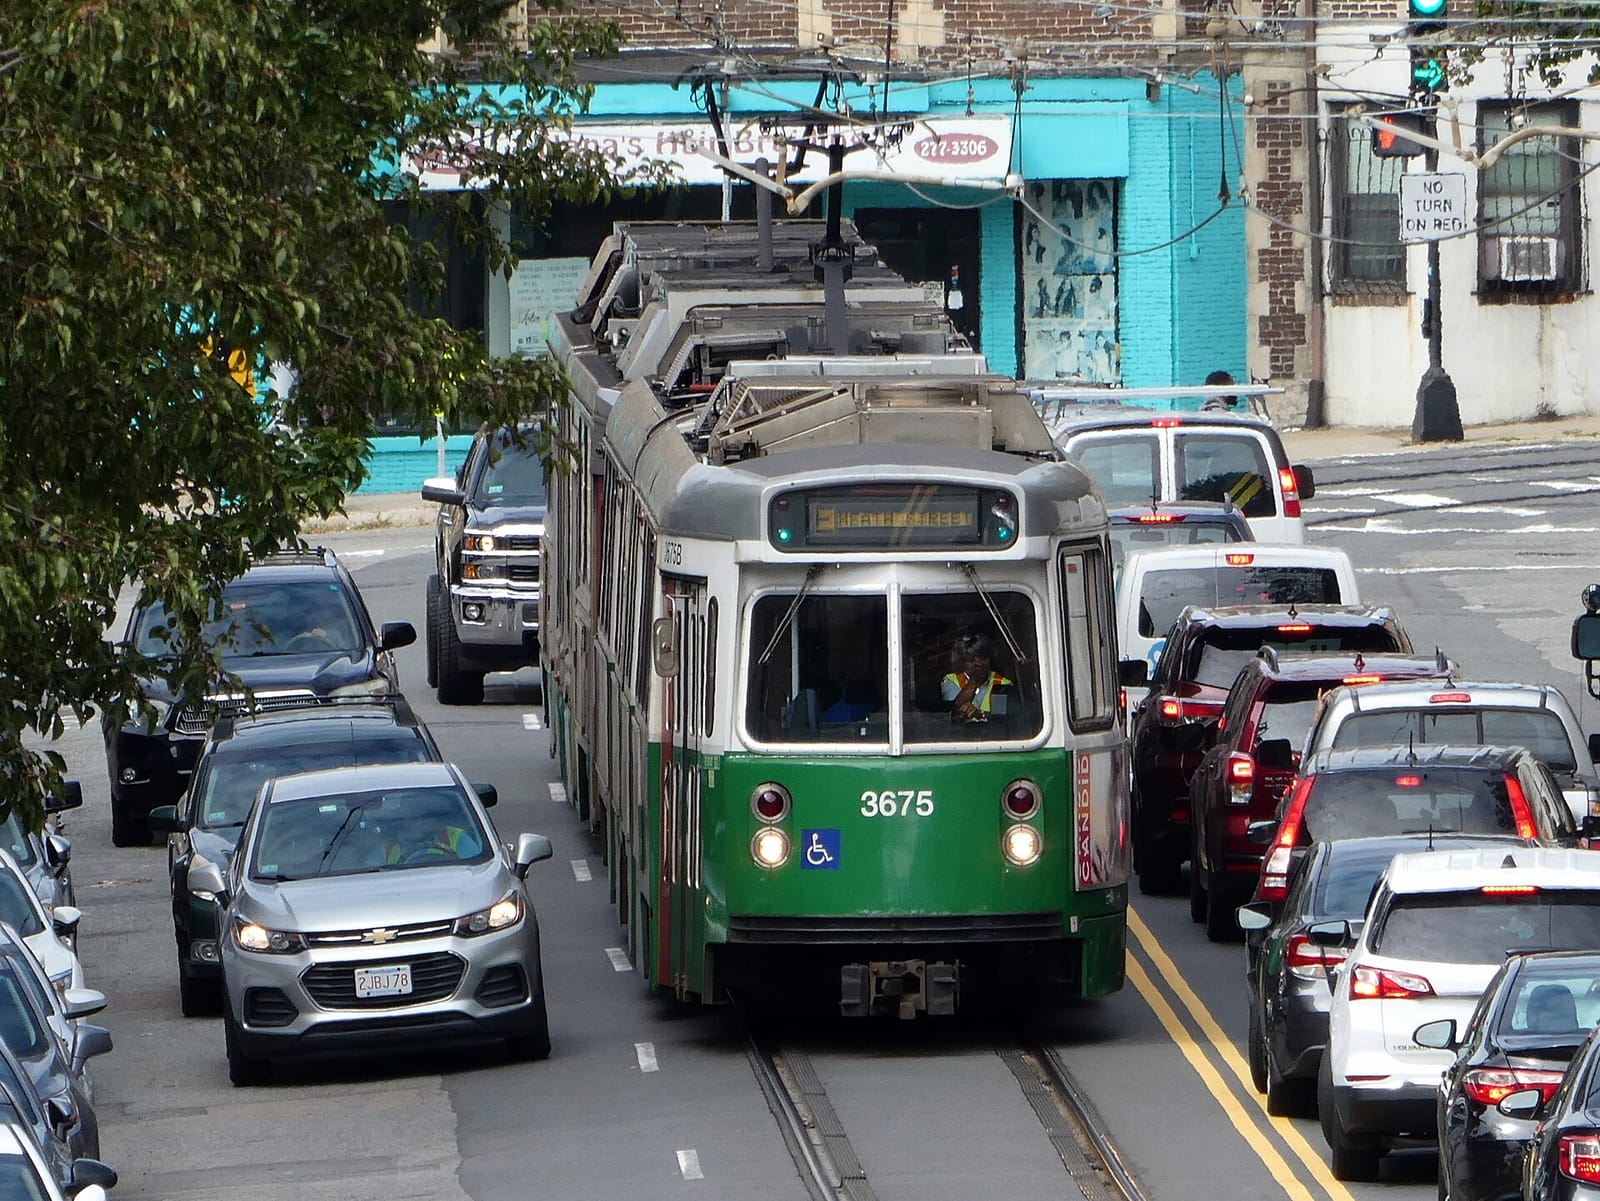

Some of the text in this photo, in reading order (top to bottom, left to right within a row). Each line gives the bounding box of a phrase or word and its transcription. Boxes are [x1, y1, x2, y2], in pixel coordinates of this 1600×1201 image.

[920, 140, 987, 157] 277-3306
[1423, 180, 1443, 193] NO
[1414, 200, 1453, 212] TURN
[1406, 217, 1463, 232] ON RED
[860, 790, 935, 818] 3675
